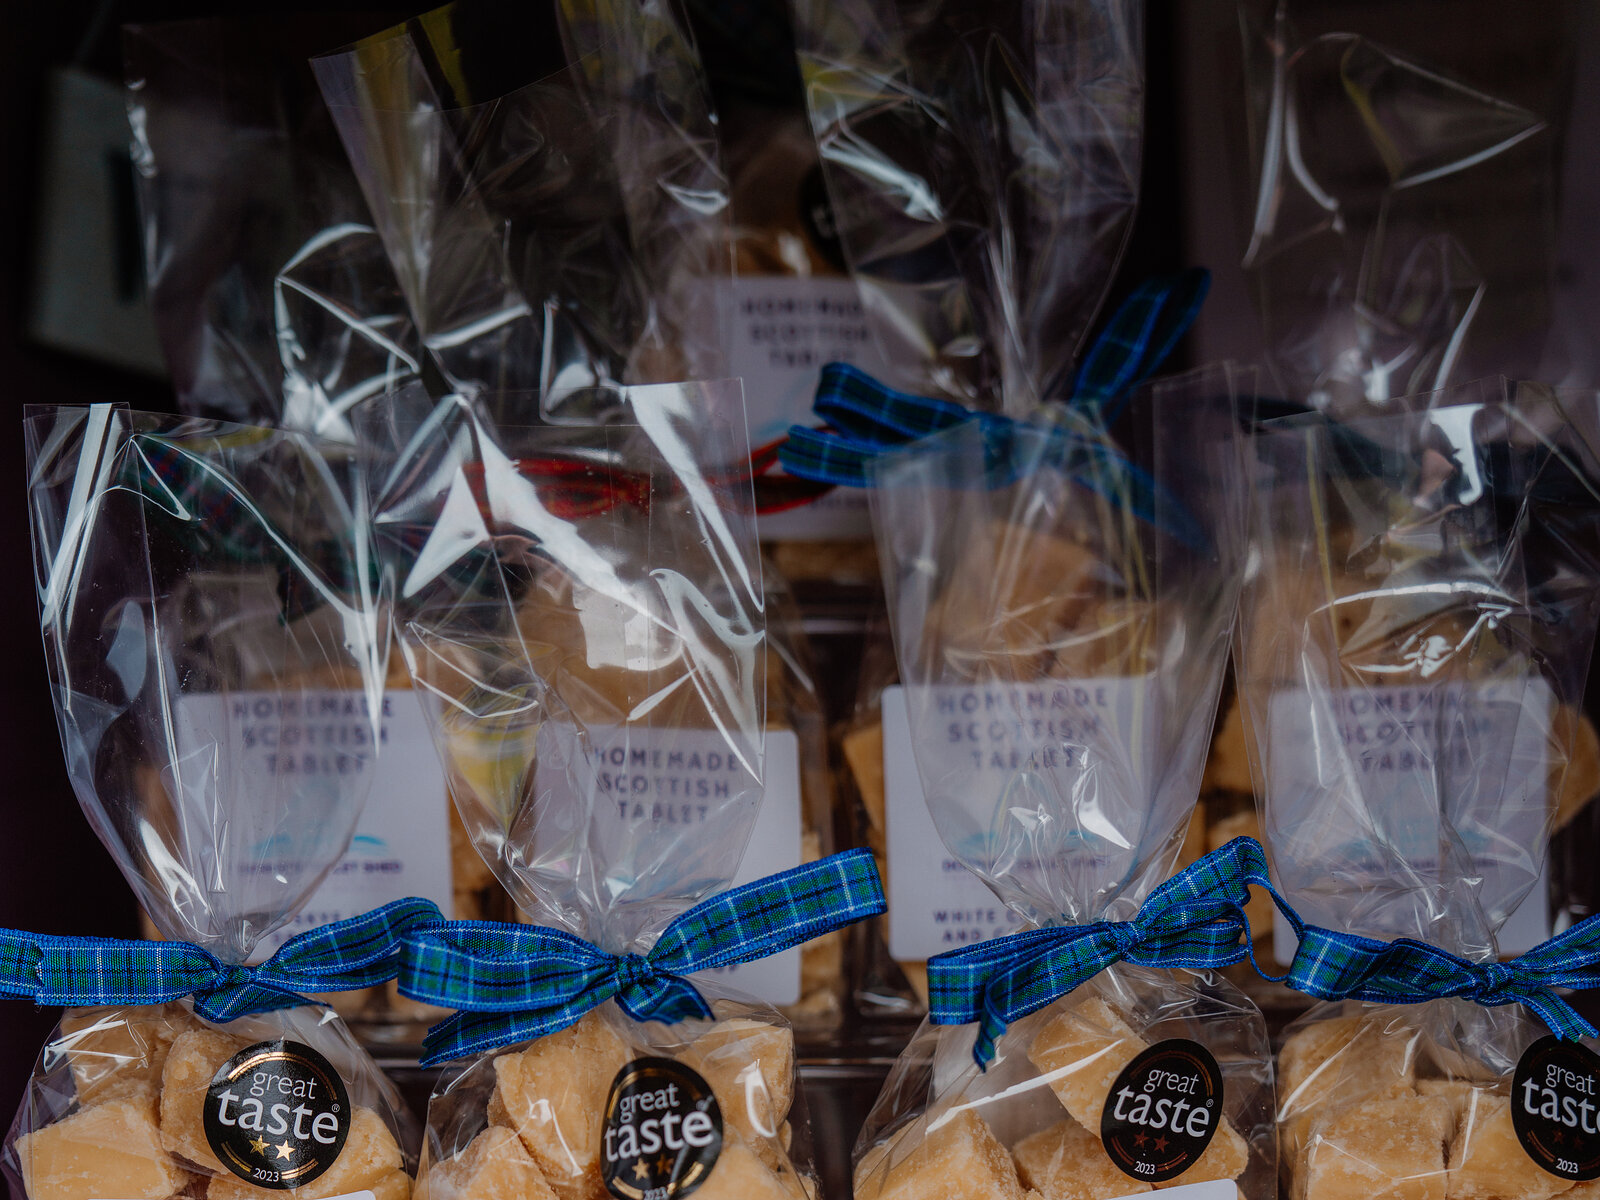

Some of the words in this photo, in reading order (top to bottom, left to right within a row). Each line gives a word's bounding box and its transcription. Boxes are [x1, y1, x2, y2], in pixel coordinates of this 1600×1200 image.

[599, 772, 729, 798] SCOTTISH
[618, 801, 709, 824] TABLET
[249, 1072, 317, 1099] great
[1143, 1069, 1199, 1095] great
[1545, 1064, 1596, 1095] great
[217, 1088, 339, 1144] taste
[619, 1082, 681, 1123] great
[1113, 1085, 1211, 1138] taste
[1521, 1077, 1600, 1134] tast
[604, 1110, 714, 1162] taste
[253, 1167, 279, 1183] 2023
[1134, 1160, 1156, 1175] 2023
[1556, 1158, 1579, 1173] 2023
